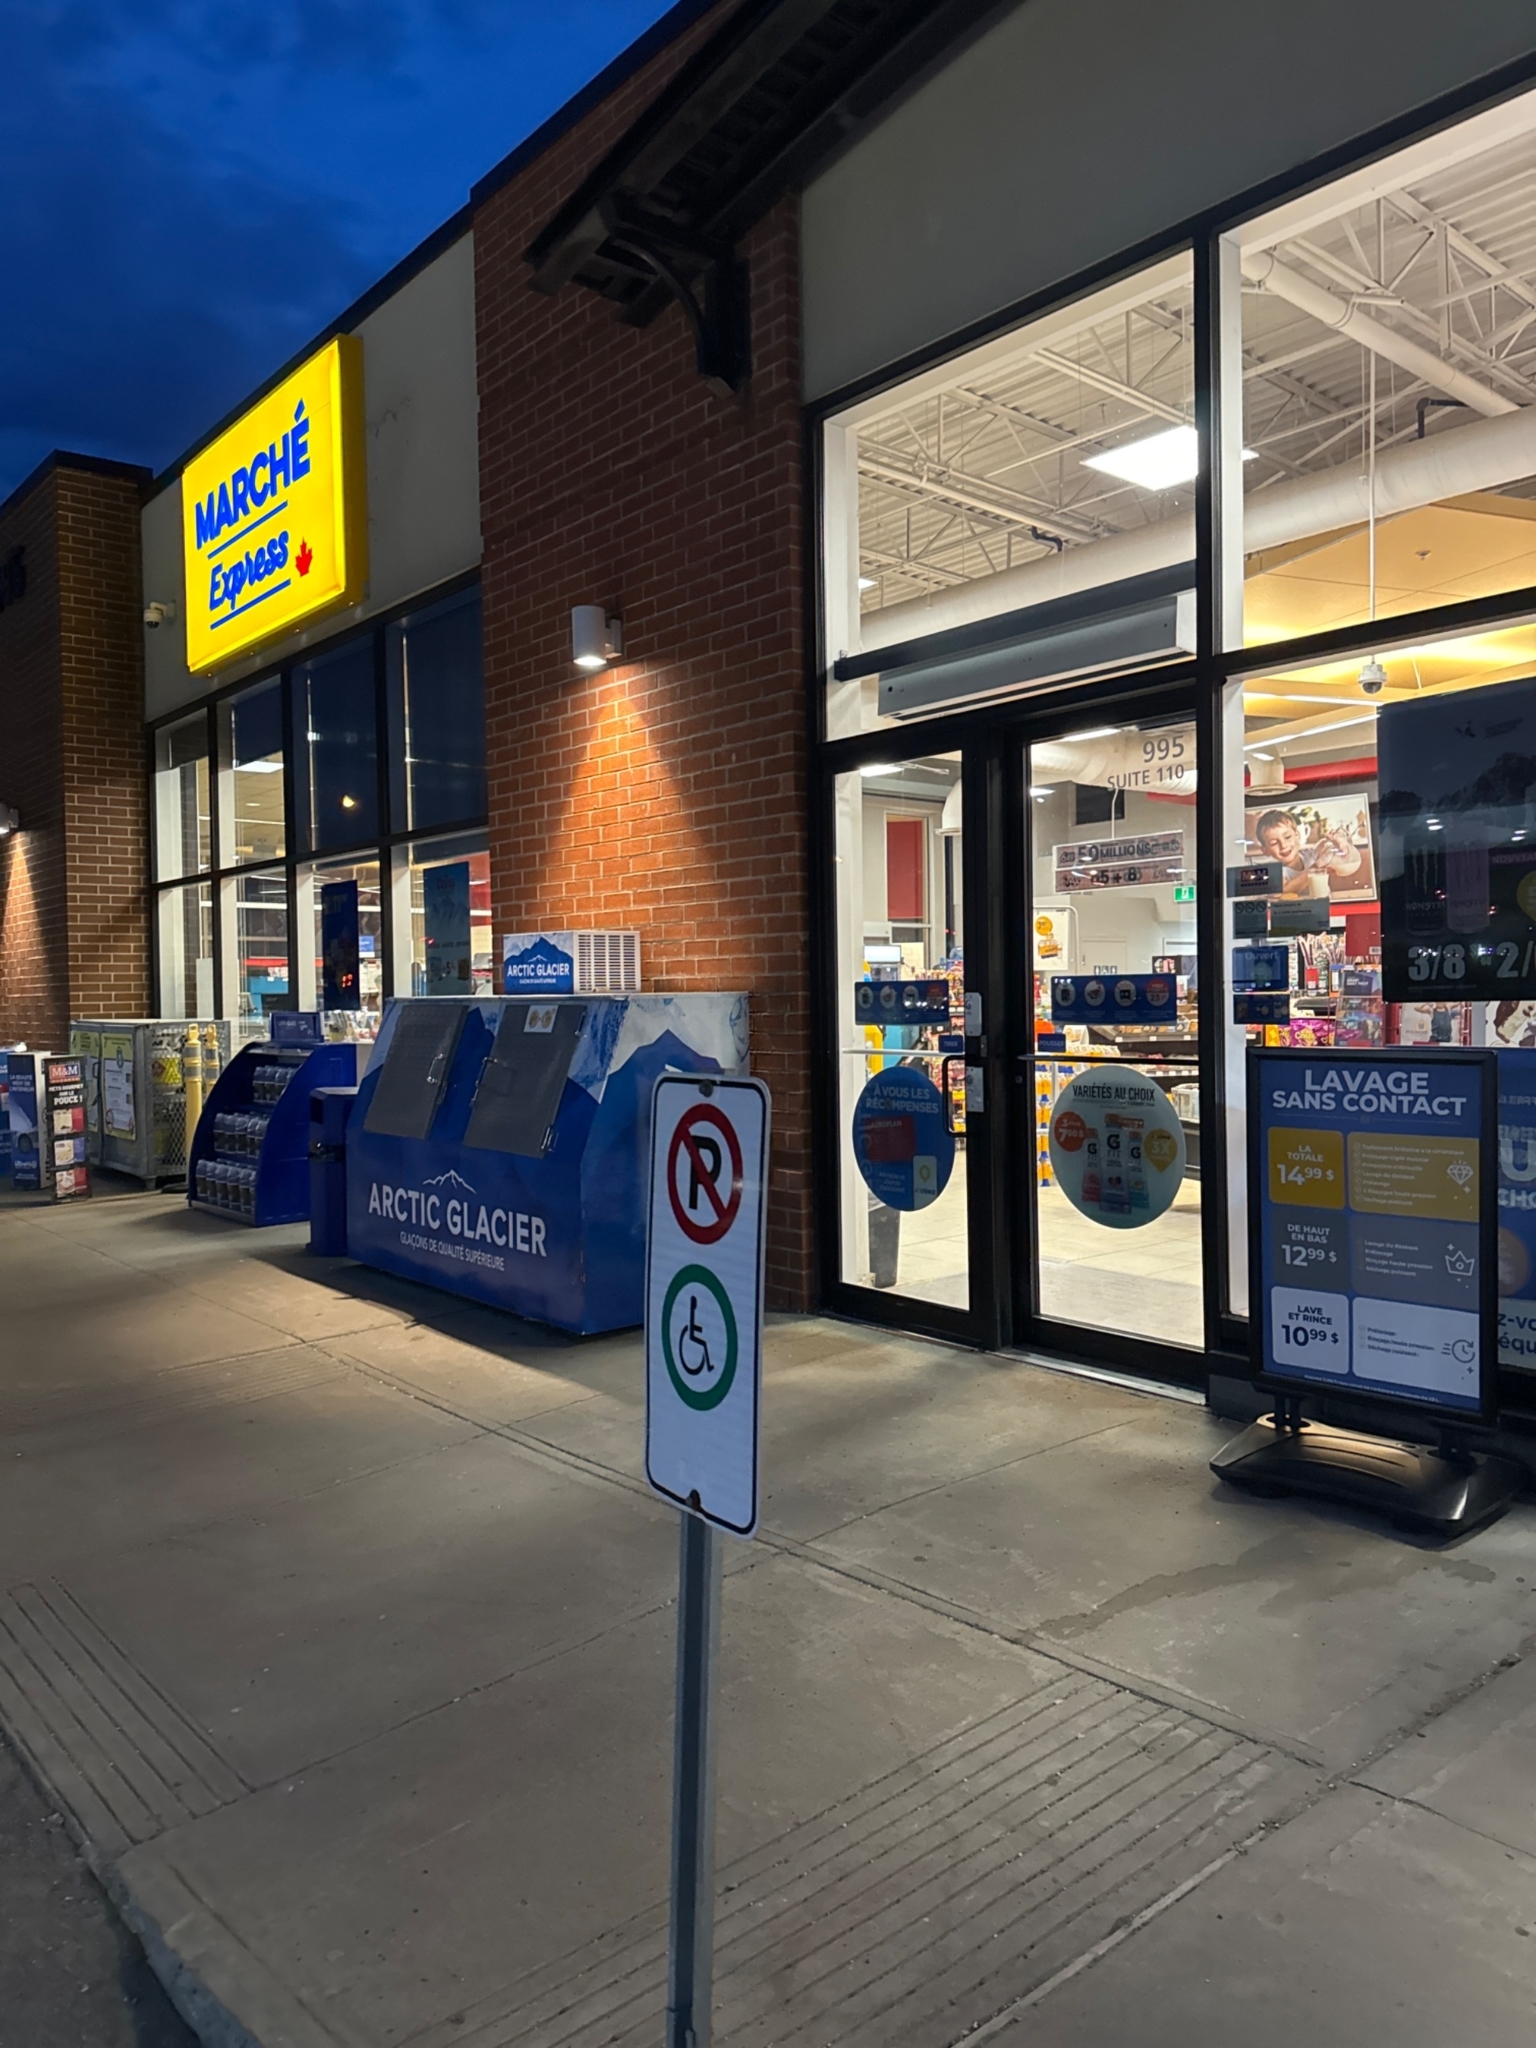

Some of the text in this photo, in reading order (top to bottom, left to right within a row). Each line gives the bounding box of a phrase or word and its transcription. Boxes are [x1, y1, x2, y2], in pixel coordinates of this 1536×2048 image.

[195, 398, 310, 550] MARCHÉ
[209, 530, 290, 612] Express
[1143, 735, 1184, 763] 995
[1107, 763, 1185, 789] SUITE 110
[1493, 852, 1536, 865] NOUVEA
[1244, 950, 1279, 961] Ouvert
[1408, 943, 1466, 981] 3/8
[1496, 940, 1536, 978] 2/
[507, 962, 570, 977] ARCTIC GLACIER
[52, 1064, 78, 1078] M&M
[1304, 1069, 1430, 1095] LAVAGE
[874, 1082, 930, 1100] À VOUS LES
[1072, 1082, 1156, 1102] VARIÉTÉS AU CHOIX
[54, 1096, 78, 1106] POUCE
[866, 1096, 940, 1114] RÉCOMPENSES
[1272, 1090, 1467, 1116] SANS CONTACT
[1087, 1142, 1098, 1155] G
[1106, 1134, 1120, 1150] G
[1298, 1144, 1312, 1153] LA
[1130, 1146, 1142, 1160] G
[1286, 1152, 1324, 1162] TOTALE
[1326, 1168, 1334, 1182] $
[368, 1182, 547, 1257] ARCTIC GLACIER
[1287, 1223, 1331, 1236] DE HAUT
[1290, 1232, 1328, 1244] EN BAS
[400, 1231, 505, 1272] GLAÇONS DE QUALITÉ SUPÉRIEURE
[1328, 1250, 1337, 1264] $
[1297, 1304, 1324, 1316] LAVE
[1288, 1312, 1332, 1326] ET RINCE
[1330, 1332, 1340, 1345] $
